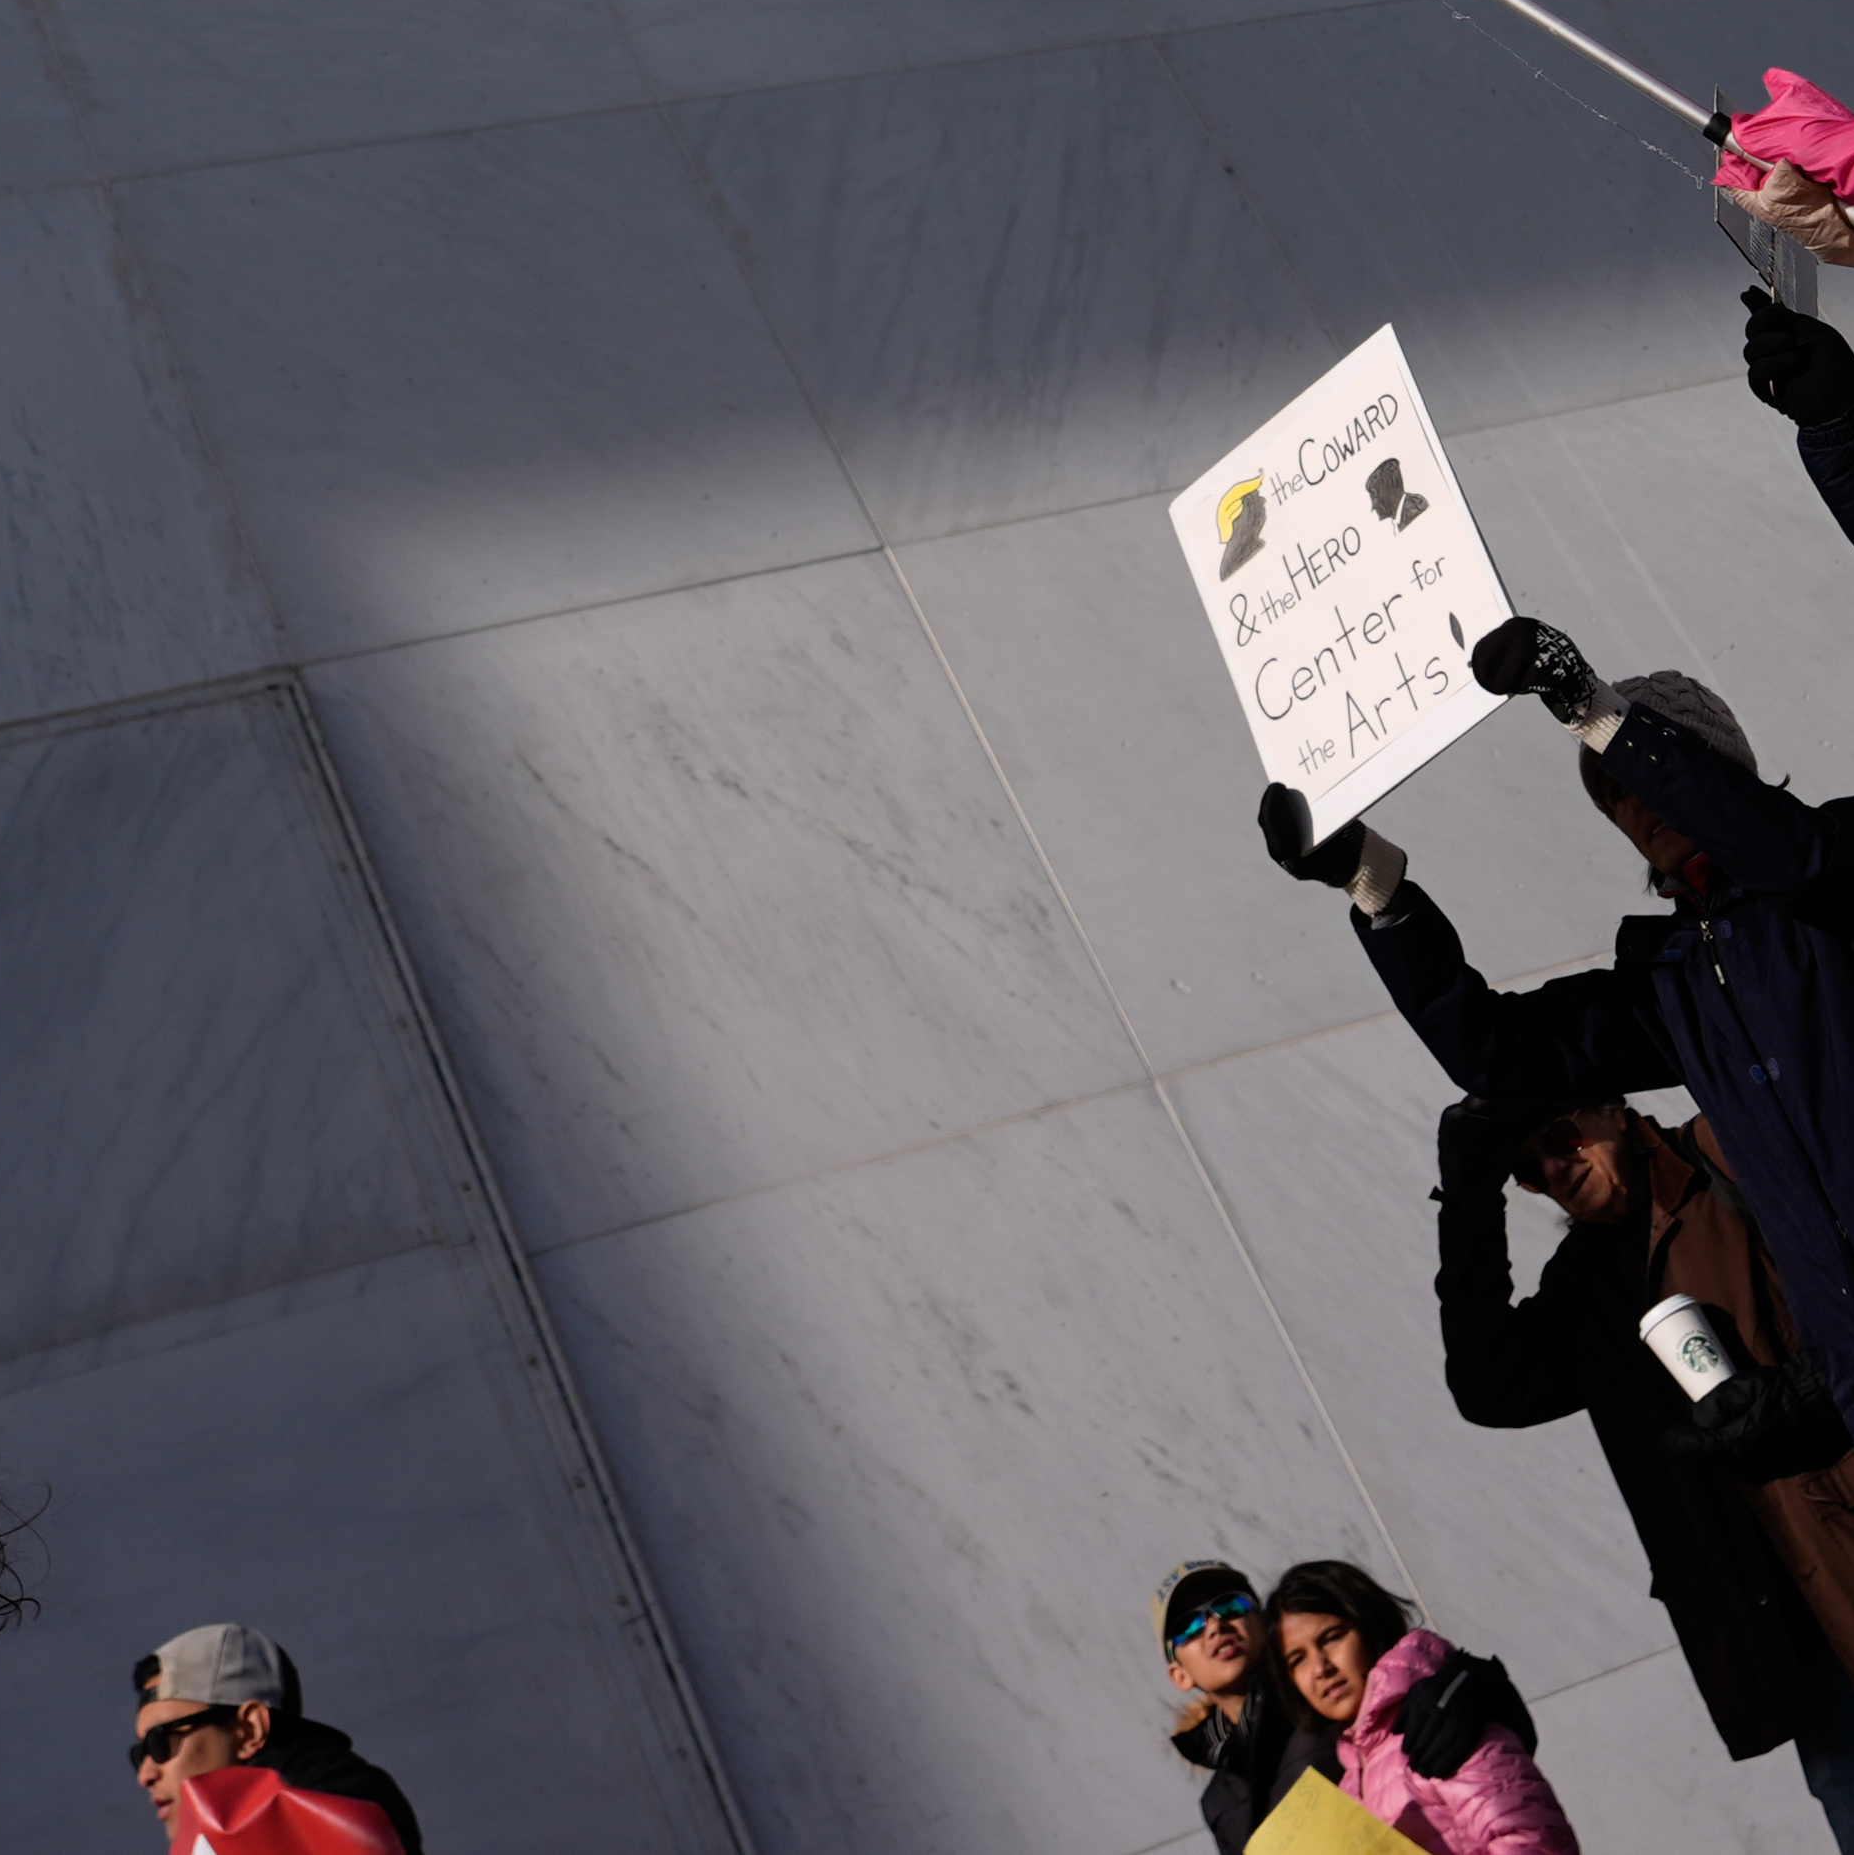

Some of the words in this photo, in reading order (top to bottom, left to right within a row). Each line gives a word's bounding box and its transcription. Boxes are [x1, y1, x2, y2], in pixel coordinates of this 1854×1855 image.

[1298, 393, 1398, 486] COWARD
[1230, 592, 1262, 647] &
[1282, 526, 1361, 601] HERO
[1255, 593, 1403, 721] Center
[1410, 556, 1445, 591] for
[1299, 739, 1336, 775] the
